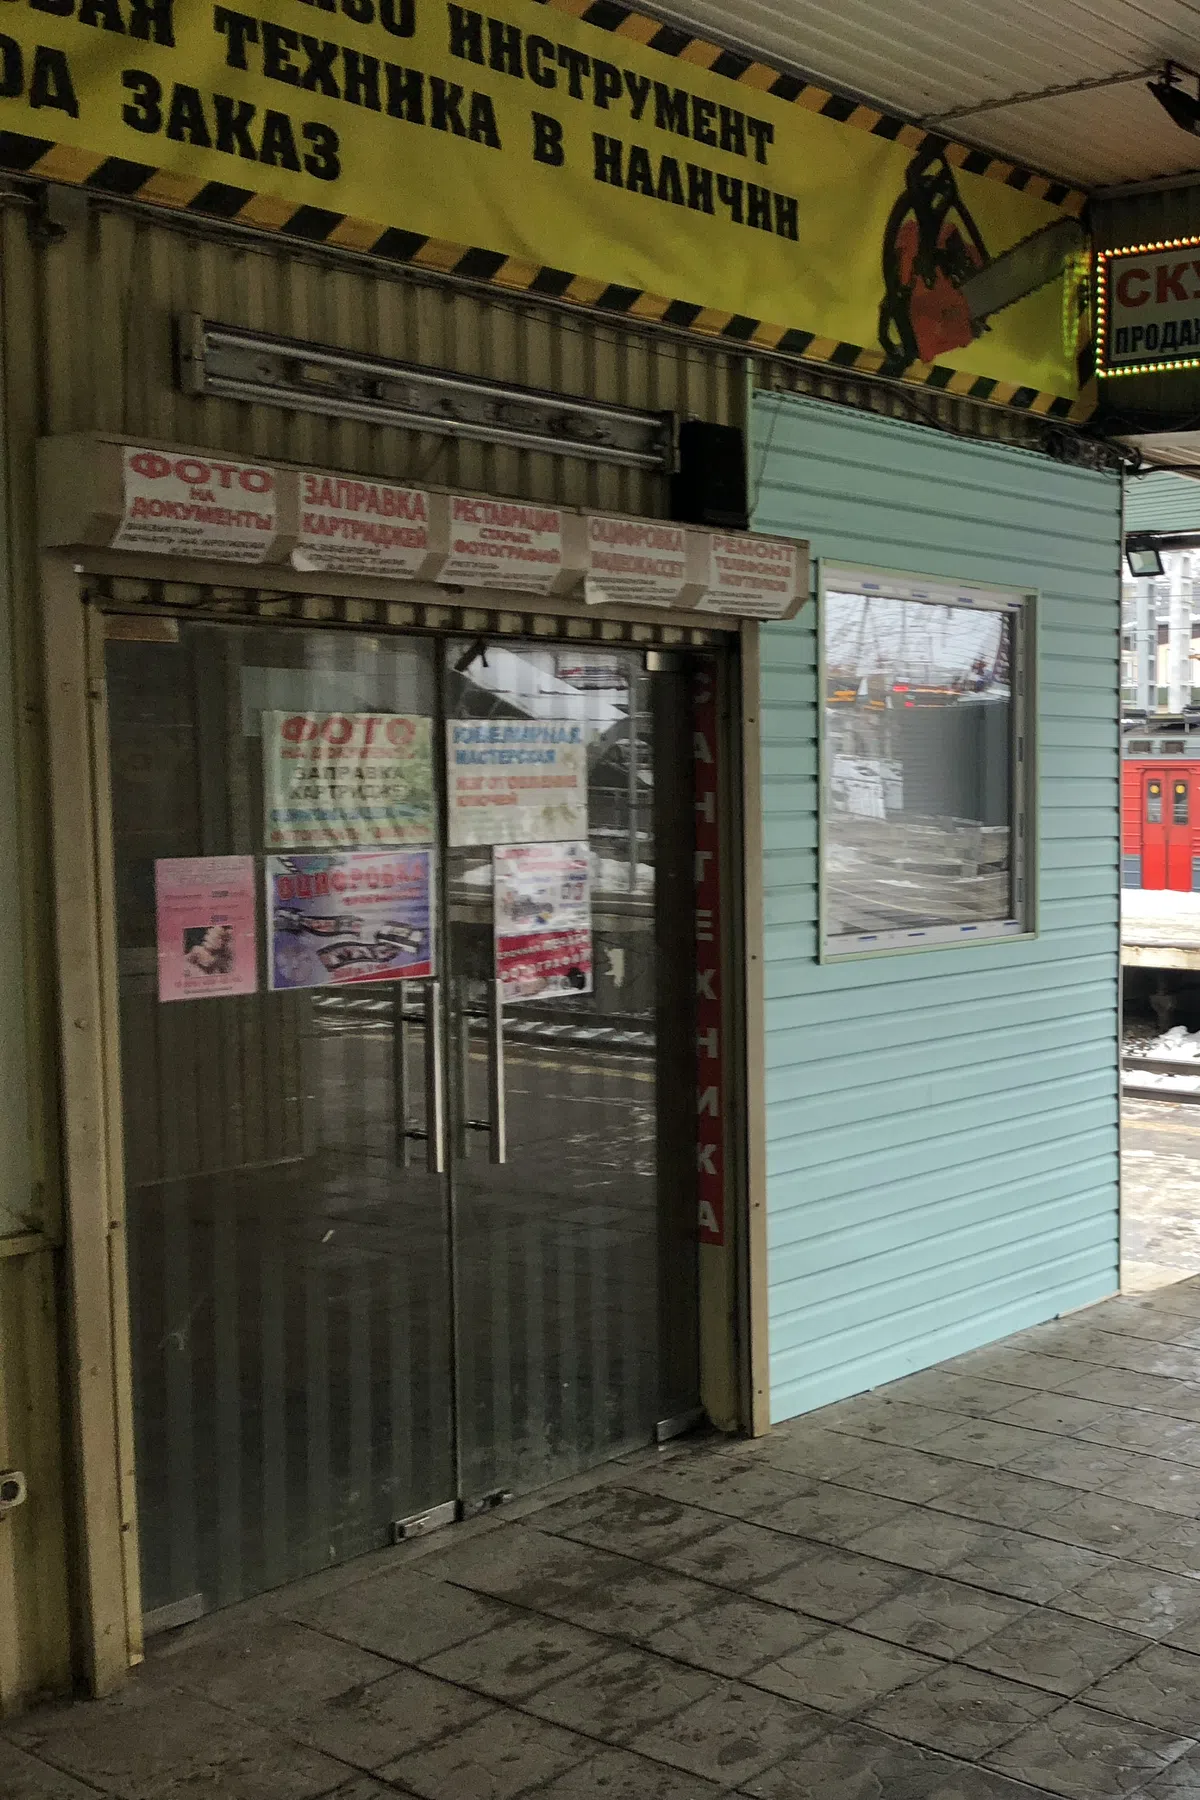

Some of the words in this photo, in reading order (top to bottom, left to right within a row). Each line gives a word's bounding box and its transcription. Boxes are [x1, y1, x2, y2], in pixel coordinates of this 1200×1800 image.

[213, 5, 501, 149] ТЕХНИКА
[533, 111, 565, 167] В
[592, 131, 801, 242] НАЛИЧИИ
[447, 3, 775, 166] ИНСТРУМЕНТ
[121, 69, 342, 182] ЗАКАЗ
[130, 452, 273, 493] ФОТО
[303, 475, 427, 521] ЗАПРАВКА
[280, 716, 416, 745] ФОТО
